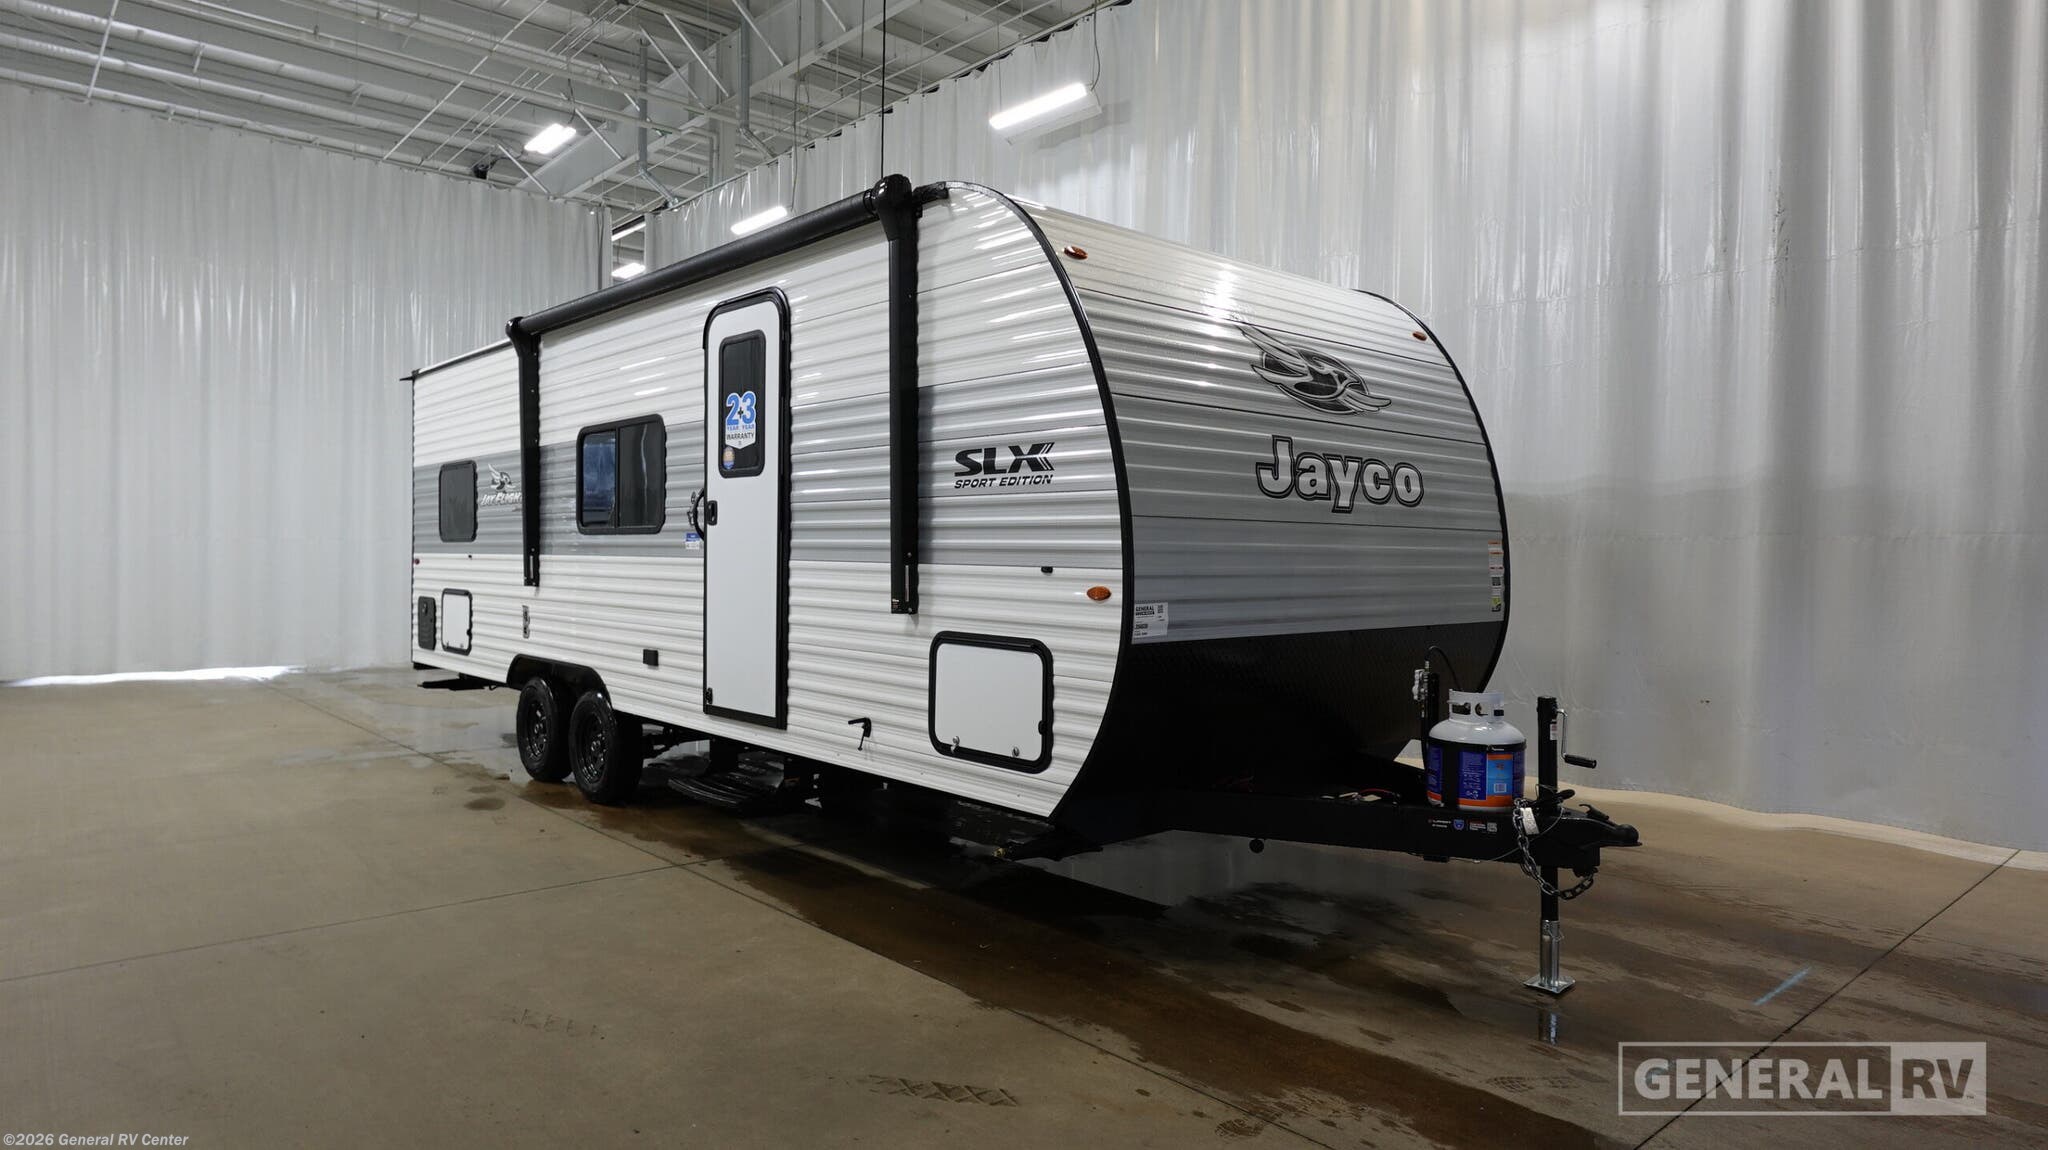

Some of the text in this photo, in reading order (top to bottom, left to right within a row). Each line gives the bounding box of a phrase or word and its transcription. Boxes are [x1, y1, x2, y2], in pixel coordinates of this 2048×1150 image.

[727, 432, 754, 440] WARRANTY
[954, 442, 1055, 477] SLX
[954, 474, 1053, 489] SPORT EDITION
[1256, 435, 1424, 513] Jayco
